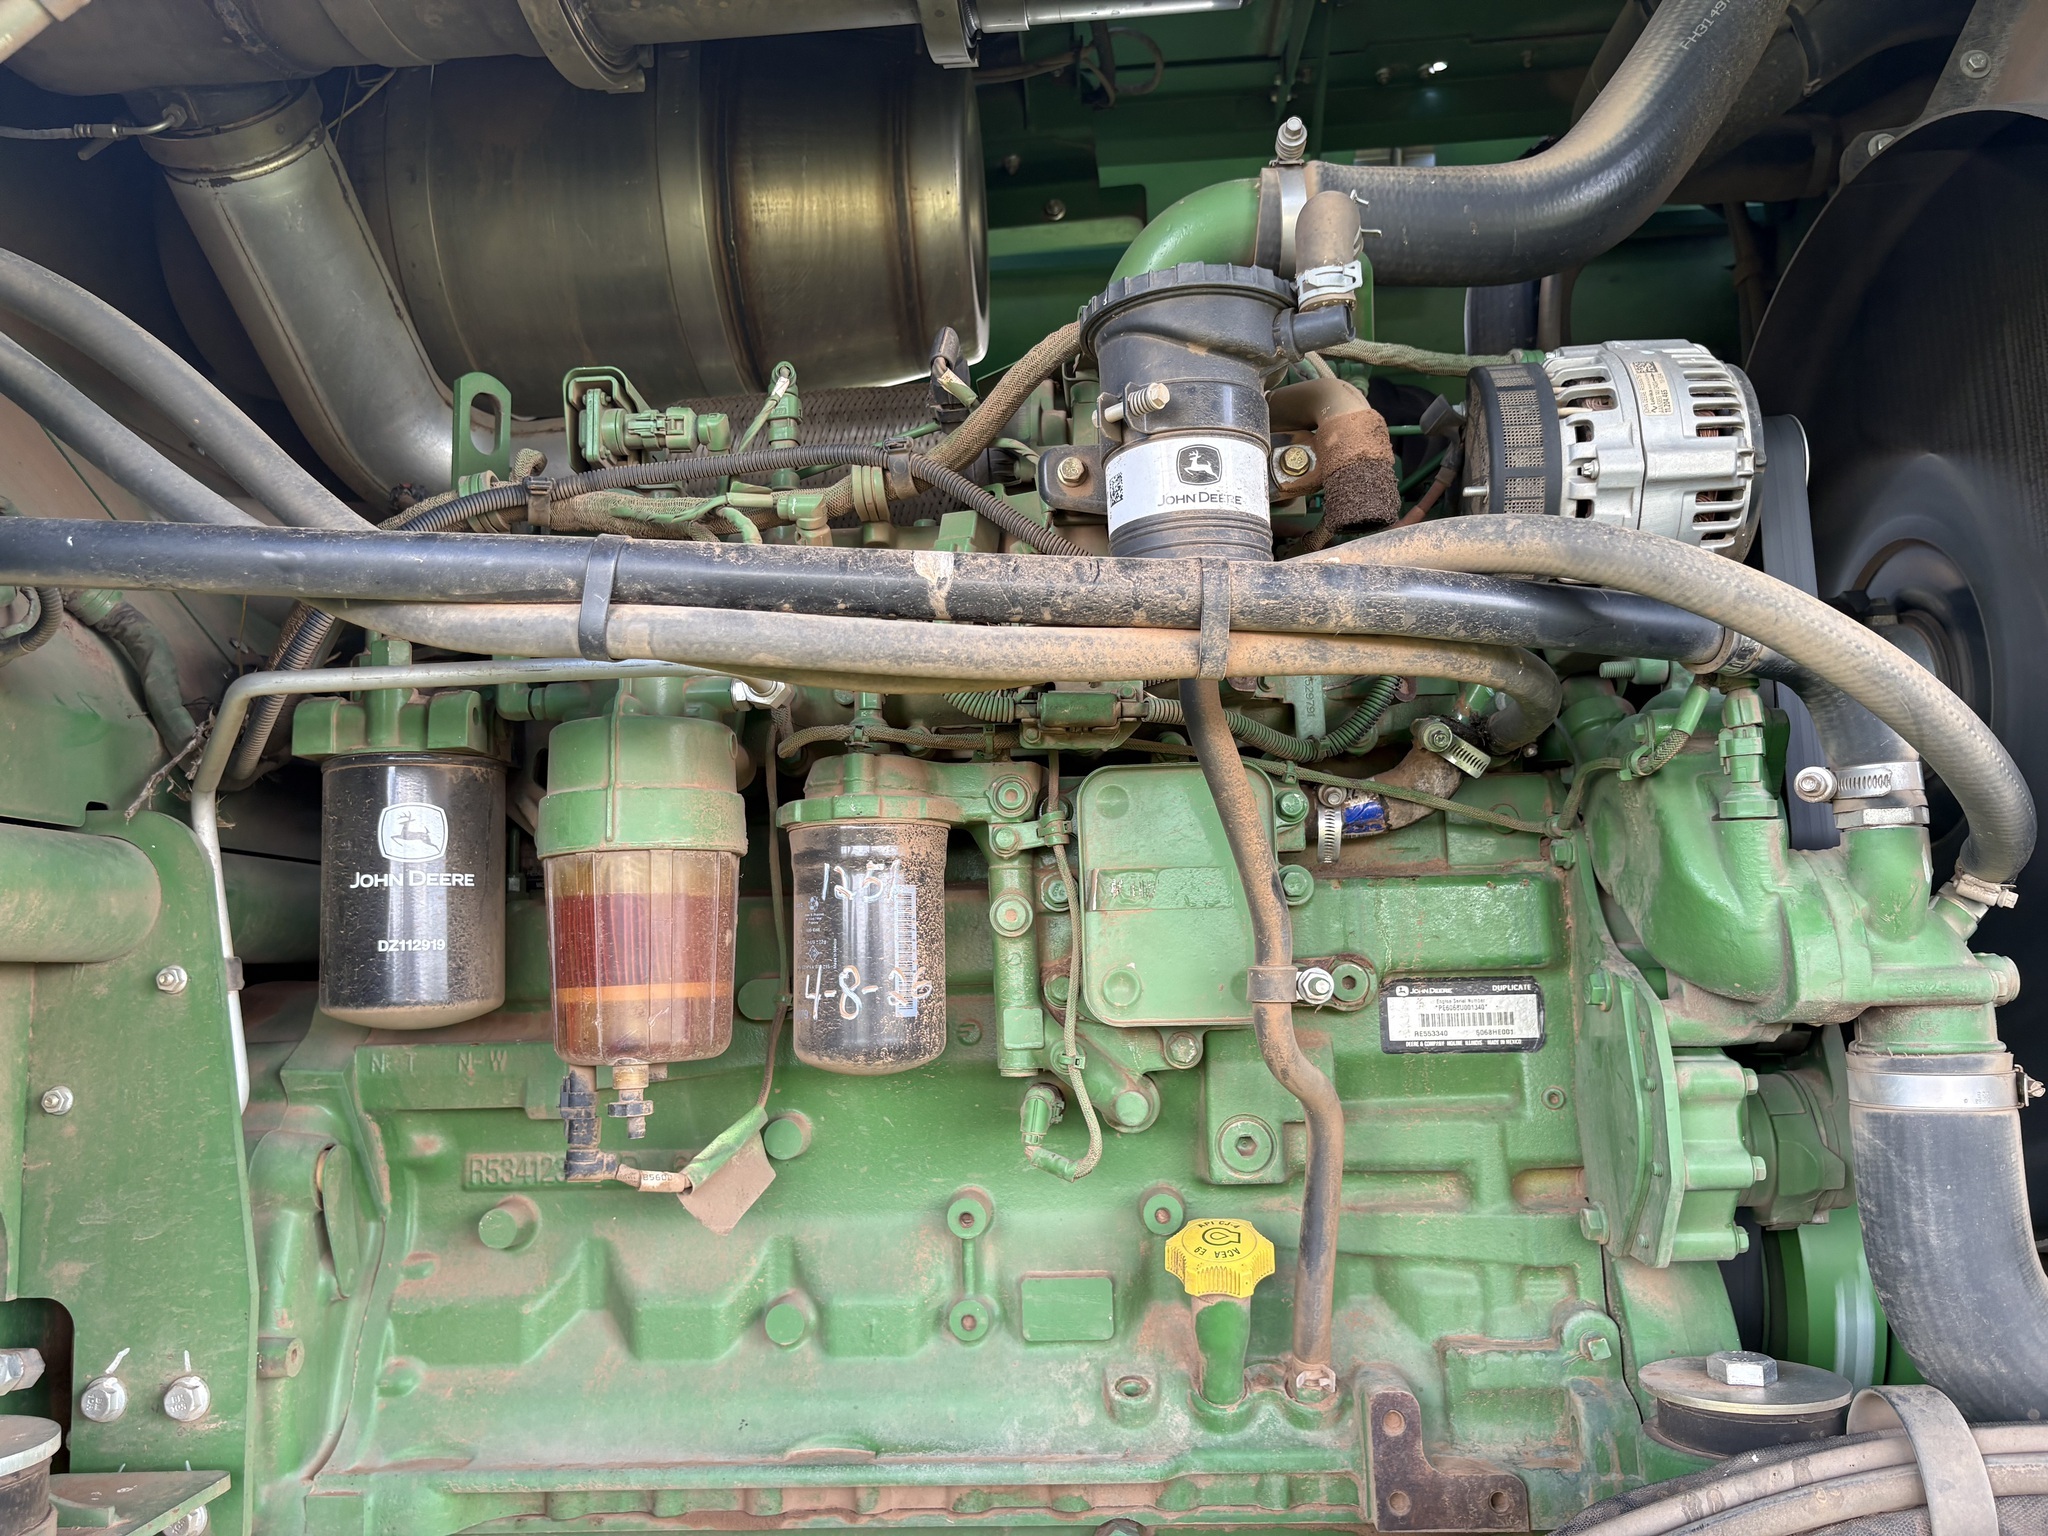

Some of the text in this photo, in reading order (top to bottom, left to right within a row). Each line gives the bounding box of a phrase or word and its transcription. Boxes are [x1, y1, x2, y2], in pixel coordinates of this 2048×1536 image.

[1679, 0, 1731, 50] FH3149
[1157, 491, 1242, 507] JOHN DEERE
[349, 869, 475, 889] JOHN DEERE
[377, 938, 446, 952] DZ112919
[1409, 987, 1429, 995] JOHN
[1491, 984, 1532, 992] DUPLICATE
[1197, 1220, 1240, 1229] API CJ-4
[1193, 1246, 1241, 1259] ACEA E9
